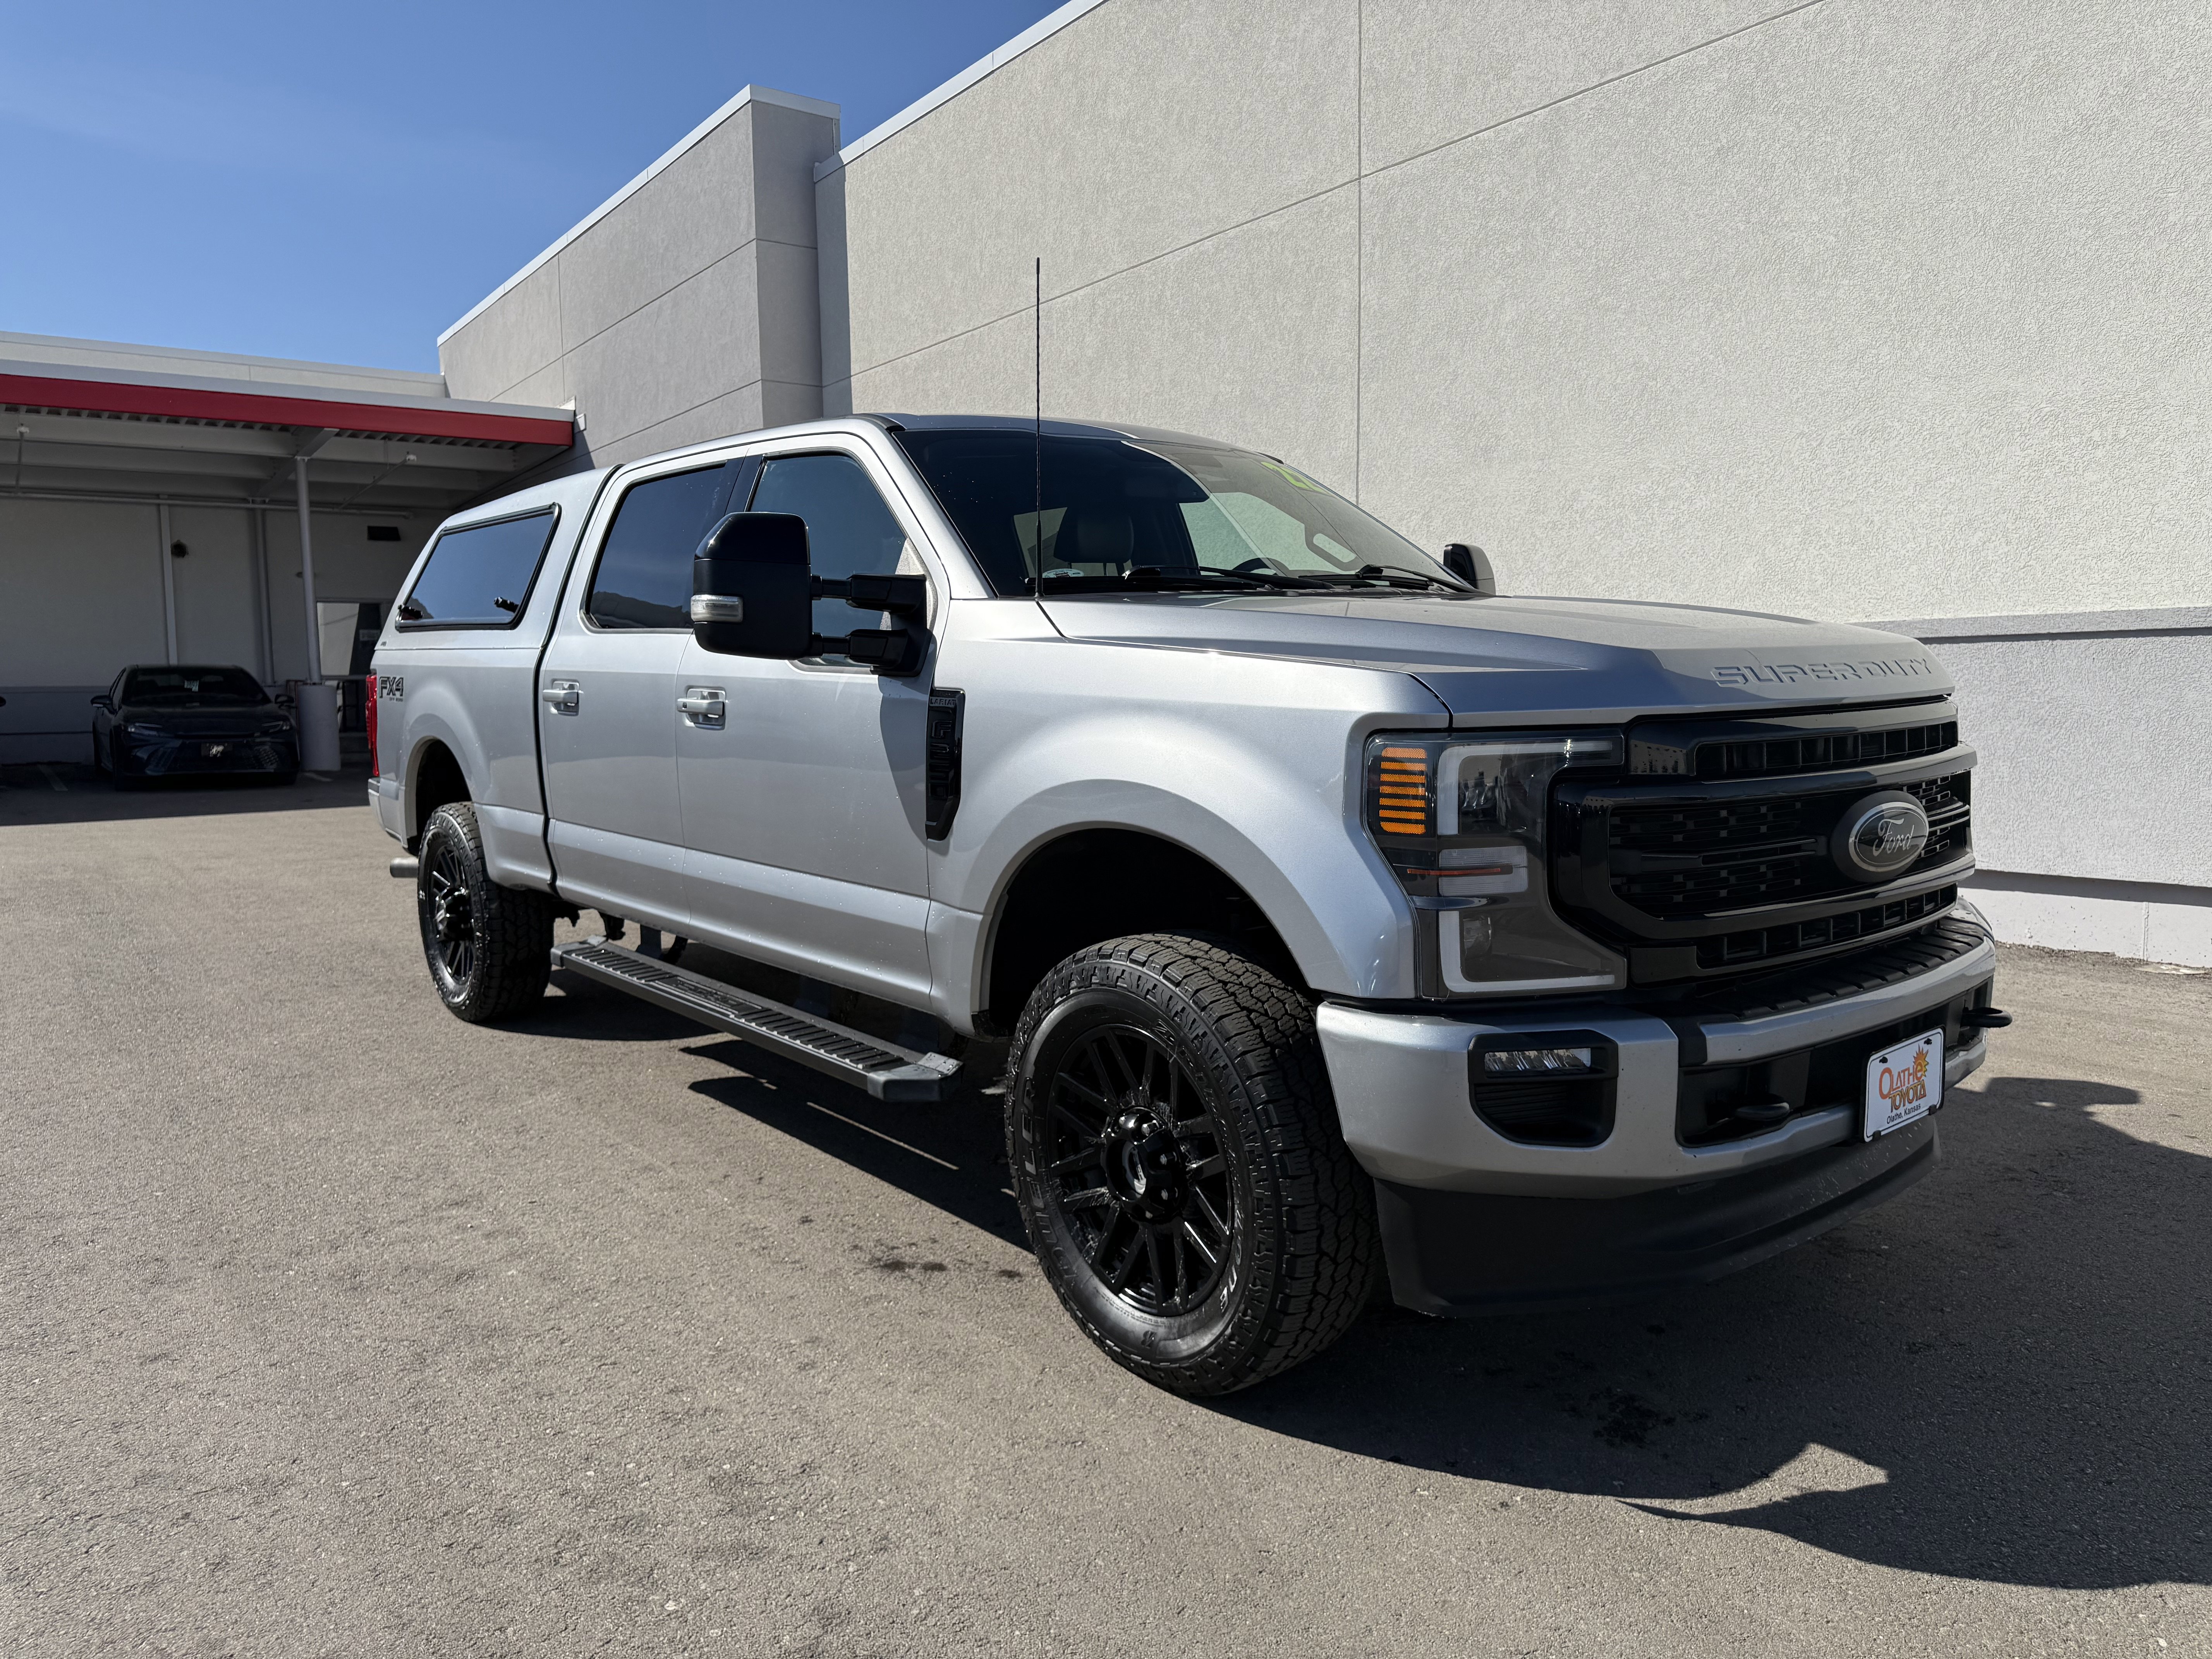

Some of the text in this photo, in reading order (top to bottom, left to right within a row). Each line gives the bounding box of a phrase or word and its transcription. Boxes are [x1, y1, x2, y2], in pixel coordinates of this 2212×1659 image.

[1711, 658, 1931, 687] SUPER DUTY
[379, 676, 404, 699] FX4
[1872, 818, 1915, 857] Ford
[1889, 1079, 1927, 1113] TOYOTA
[1887, 1103, 1921, 1124] Olathe, Kansas
